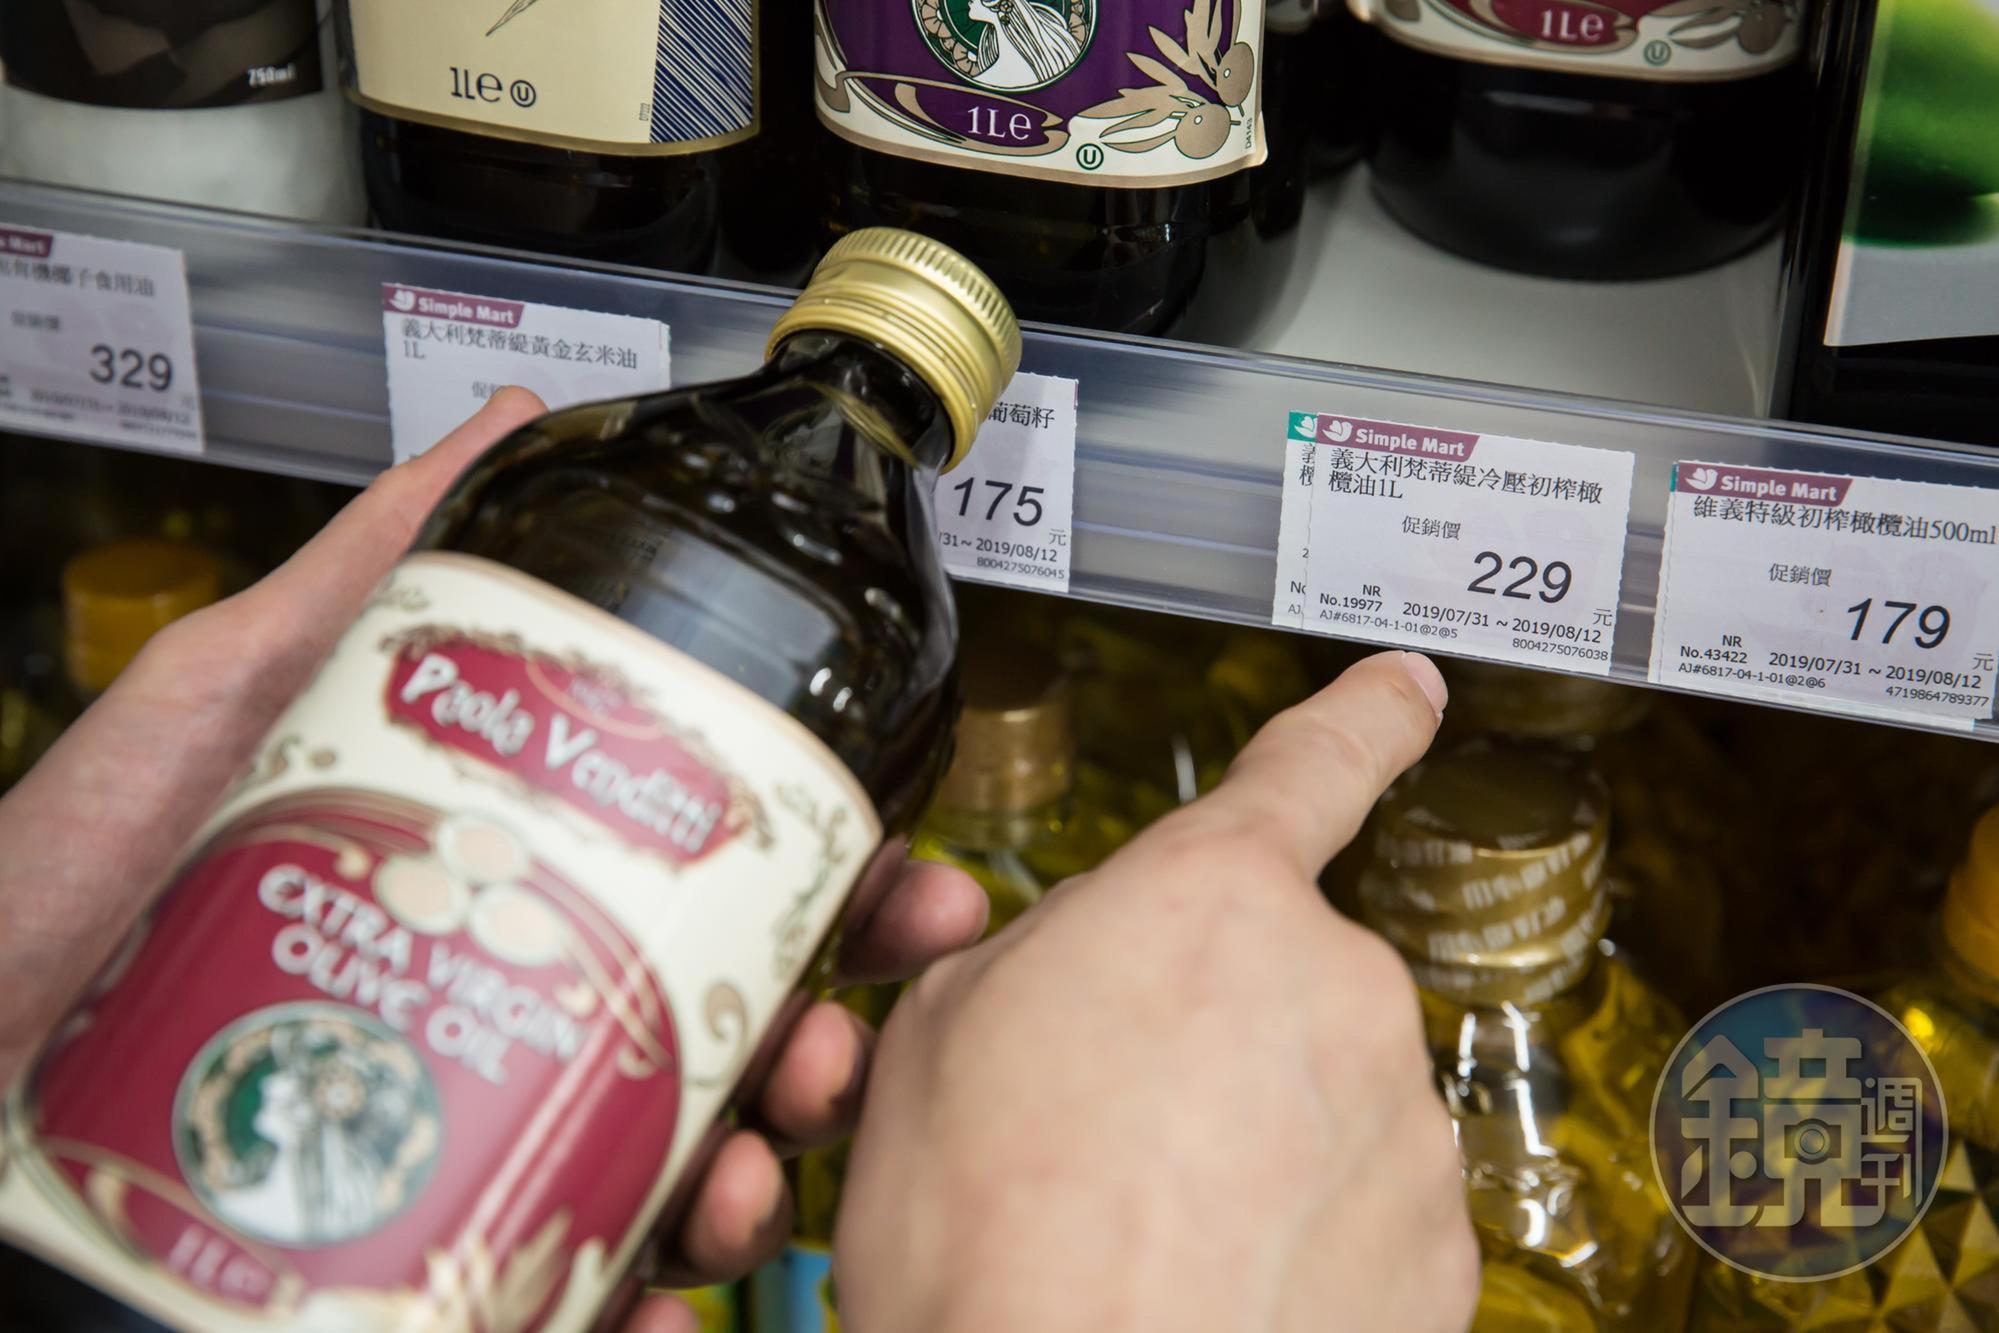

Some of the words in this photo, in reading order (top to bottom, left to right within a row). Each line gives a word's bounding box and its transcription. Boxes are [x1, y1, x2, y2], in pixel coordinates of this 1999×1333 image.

[418, 296, 473, 320] Simple
[476, 305, 515, 324] Mart
[403, 339, 425, 360] 1L
[89, 344, 173, 393] 329
[1356, 428, 1417, 451] Simple
[1422, 437, 1465, 457] Mart
[1328, 469, 1403, 499] 欖油1L
[1331, 447, 1603, 504] 義大利梵蒂緹冷壓初榨橄
[1720, 475, 1786, 498] Simple
[1791, 483, 1837, 502] Mart
[954, 477, 1045, 527] 175
[1401, 515, 1461, 540] 促銷價
[1693, 496, 1996, 545] 維義特級初榨橄欖油500ml
[976, 537, 1057, 563] 2019/08/12
[1049, 528, 1067, 547] 元
[977, 557, 1065, 580] 8004275076045
[1467, 551, 1572, 604] 229
[1769, 563, 1832, 587] 促銷價
[1319, 593, 1383, 612] No.19977
[1362, 584, 1382, 597] NR
[1402, 602, 1489, 627] 2019/07/31
[1512, 618, 1601, 643] 2019/08/12
[1593, 608, 1613, 627] 元
[1848, 598, 1951, 649] 179
[1512, 638, 1608, 661] 8004275076038
[1722, 635, 1742, 648] NR
[1680, 646, 1748, 664] No.43422
[1973, 652, 1994, 672] 元
[1769, 652, 1861, 675] 2019/07/31
[1886, 665, 1982, 689] 2019/08/12
[1886, 686, 1990, 708] 4719864789377
[257, 863, 412, 976] EXTRA
[426, 941, 581, 1063] VIRGIN
[271, 922, 430, 1031] OLIVE
[425, 1003, 509, 1085] OIL
